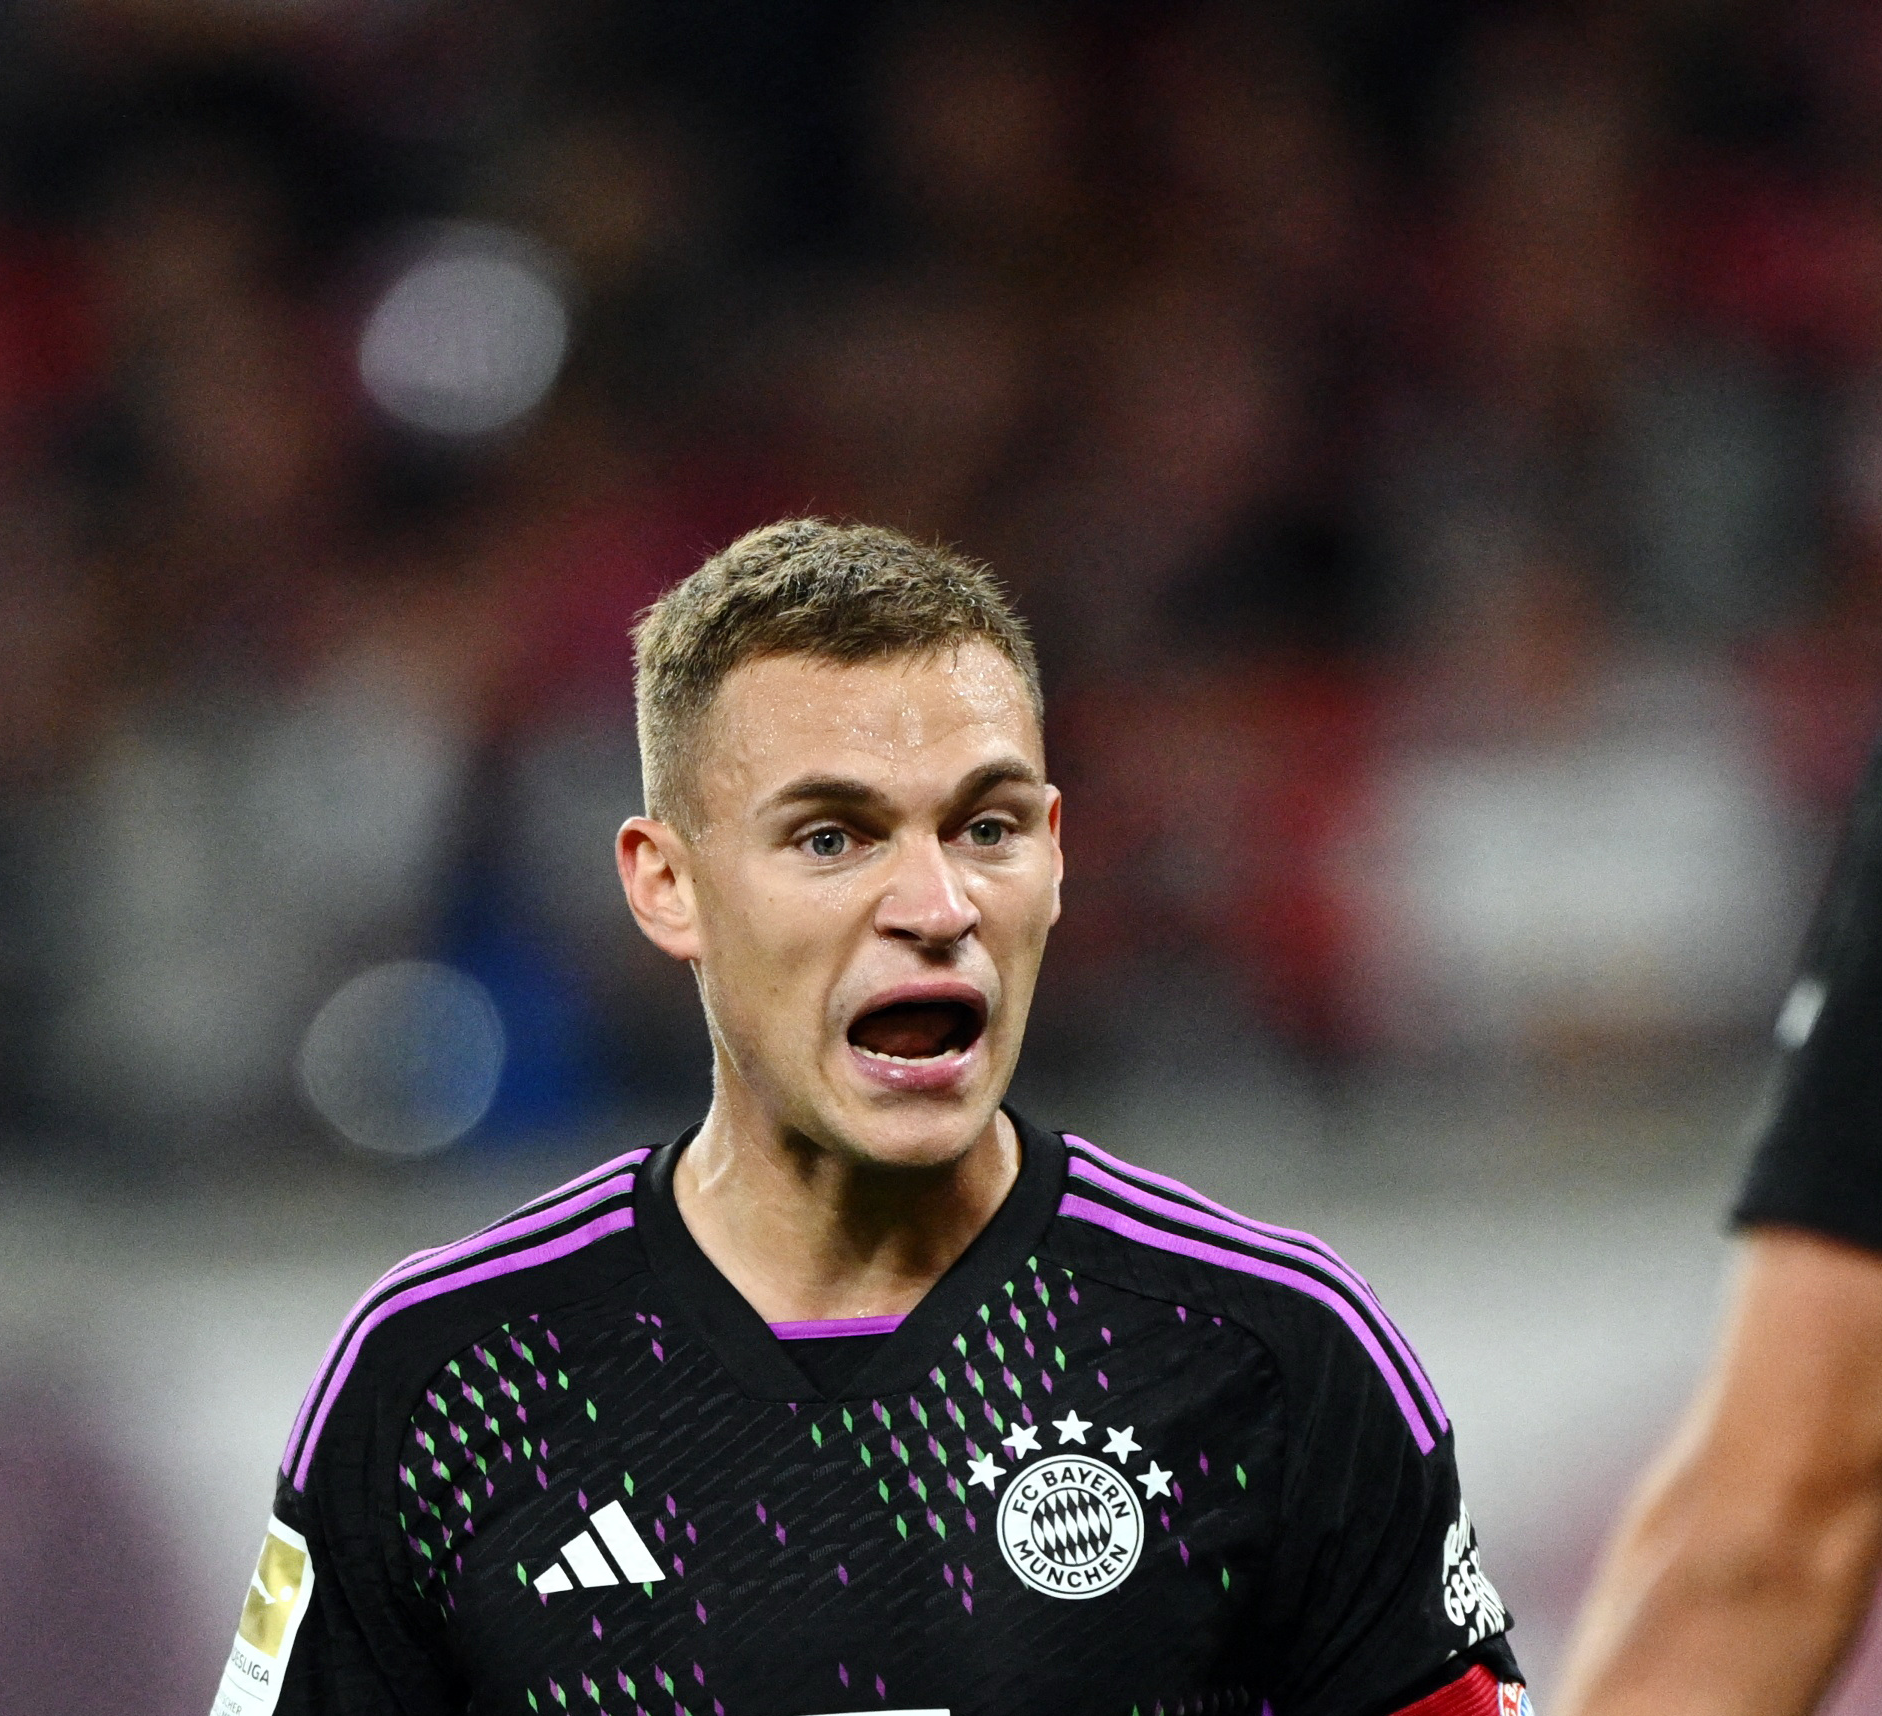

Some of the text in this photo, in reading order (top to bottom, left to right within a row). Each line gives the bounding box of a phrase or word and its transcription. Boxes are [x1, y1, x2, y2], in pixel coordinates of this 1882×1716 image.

[1012, 1466, 1131, 1519] FC BAYERN
[1012, 1539, 1129, 1589] MÜNCHEN
